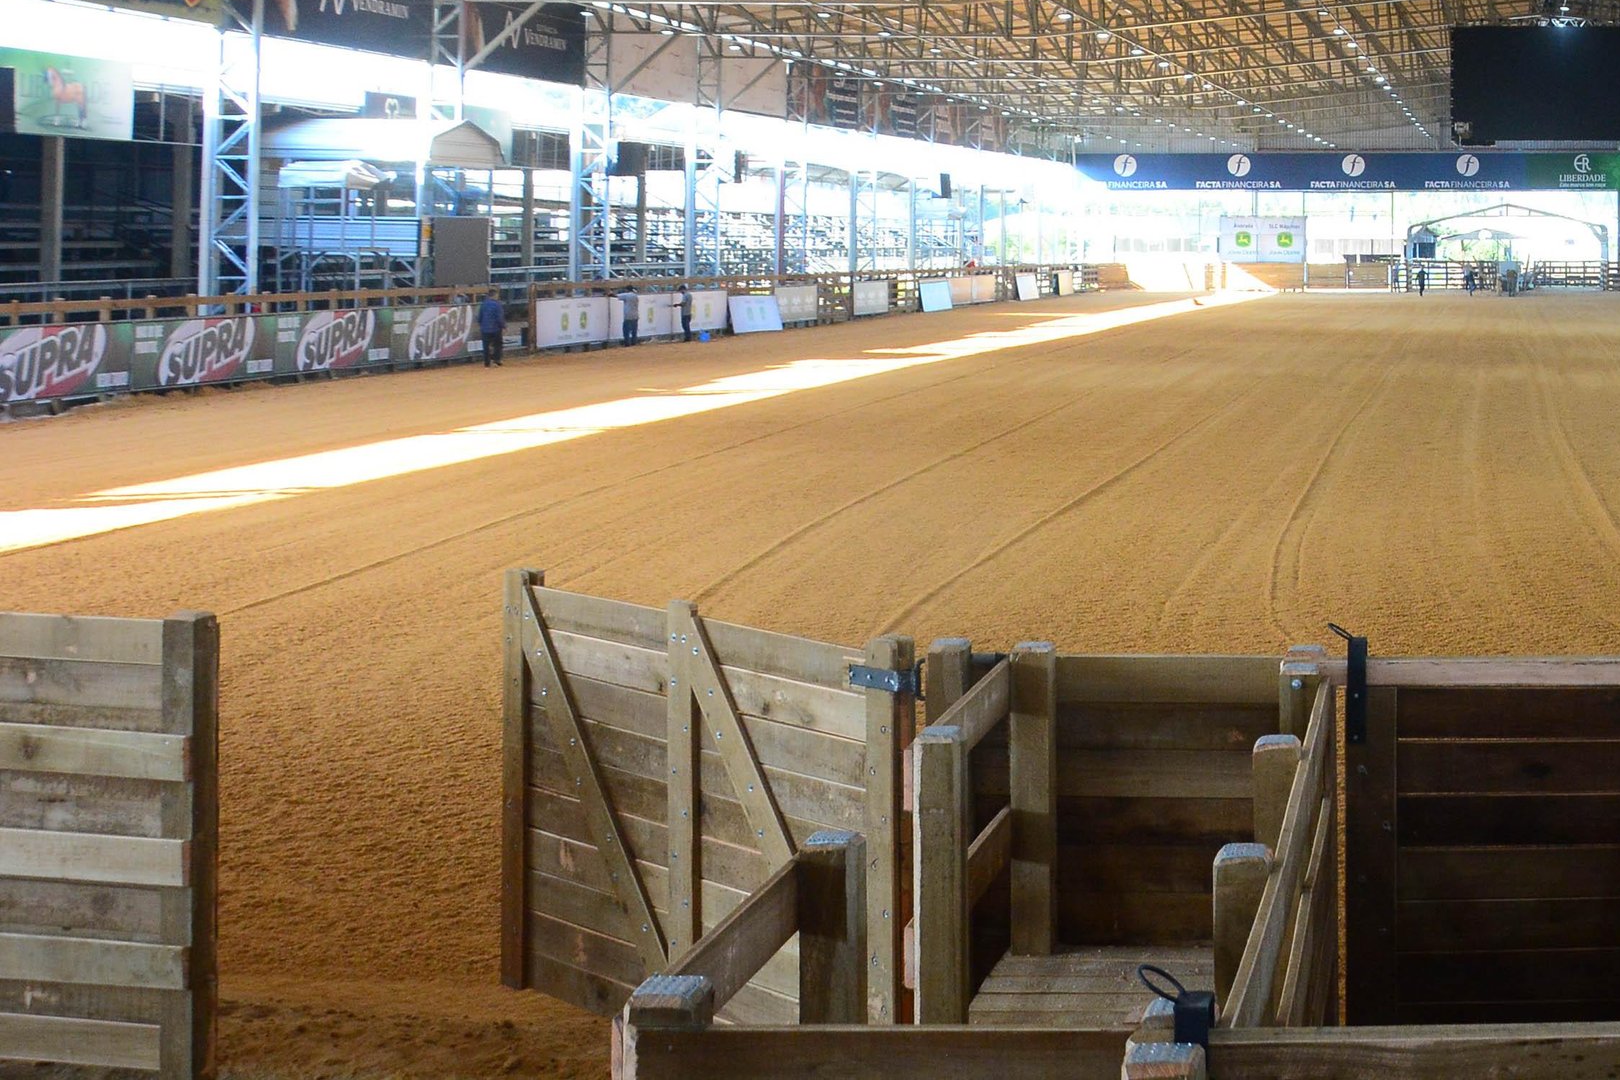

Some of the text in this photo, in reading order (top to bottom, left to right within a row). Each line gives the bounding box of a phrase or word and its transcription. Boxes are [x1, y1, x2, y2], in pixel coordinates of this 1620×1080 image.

[524, 28, 568, 51] VENDRAMIN
[1559, 174, 1606, 182] LIBERDADE
[167, 318, 247, 386] SUPRA
[305, 310, 368, 370] SUPRA
[415, 306, 466, 361] SUPRA
[0, 324, 94, 403] SUPRA
